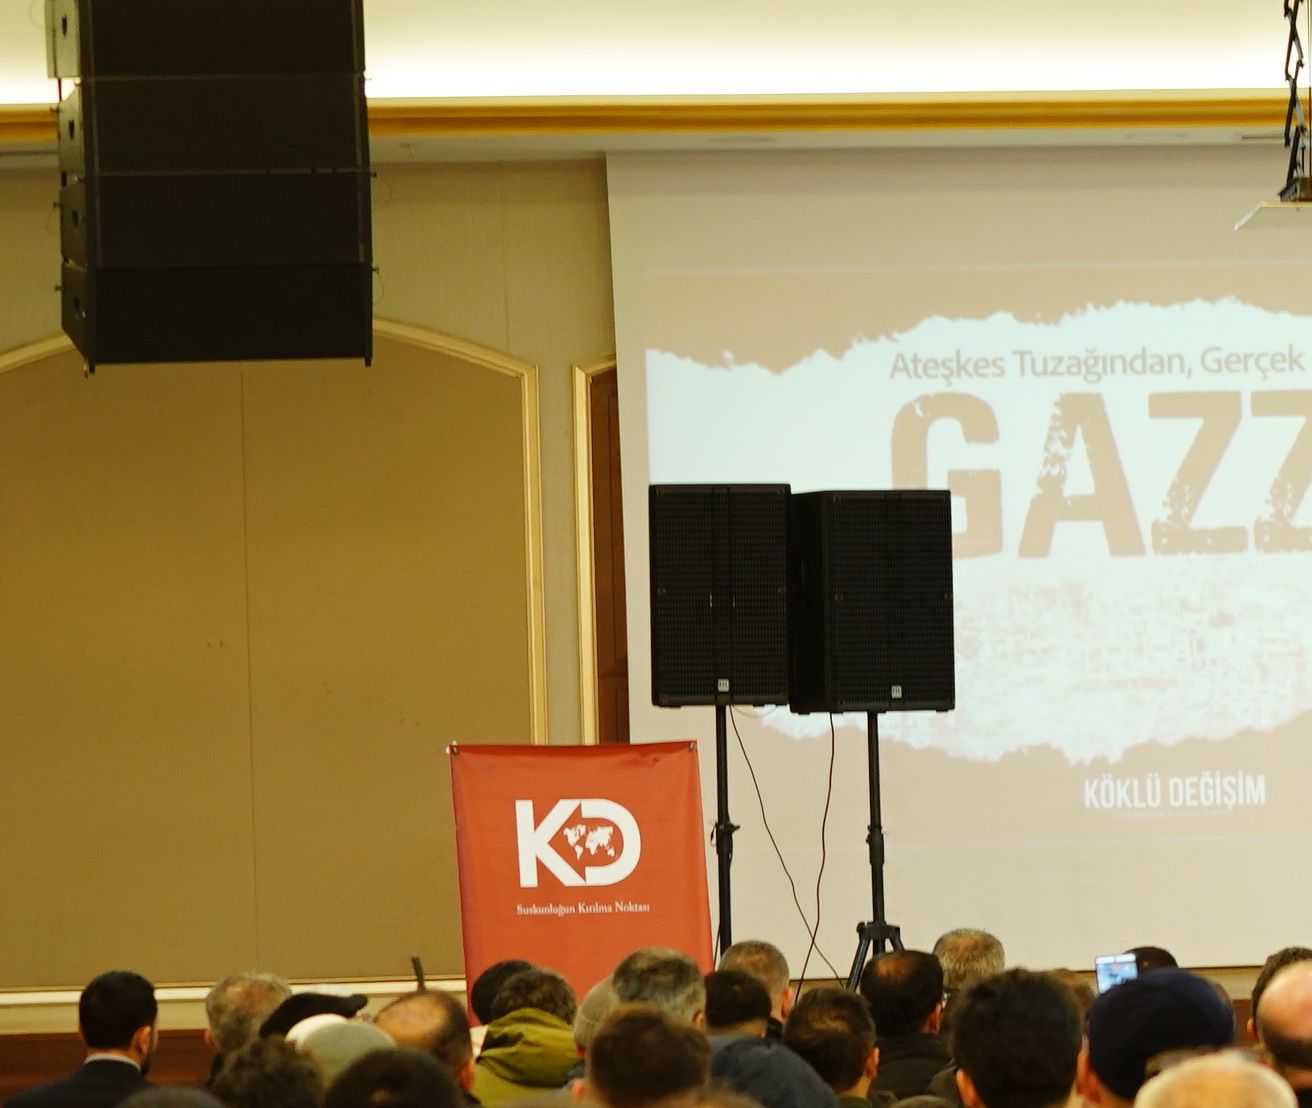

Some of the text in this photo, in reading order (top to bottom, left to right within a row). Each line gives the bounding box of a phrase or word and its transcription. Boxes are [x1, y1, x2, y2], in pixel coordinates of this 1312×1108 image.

[889, 350, 1006, 386] Ateşkes
[1012, 347, 1193, 384] Tuzağından,
[1200, 344, 1305, 380] Gerçek
[1084, 771, 1267, 811] KÖKLÜ DEĞİŞİM
[514, 797, 642, 888] KD
[614, 900, 651, 913] Noktası
